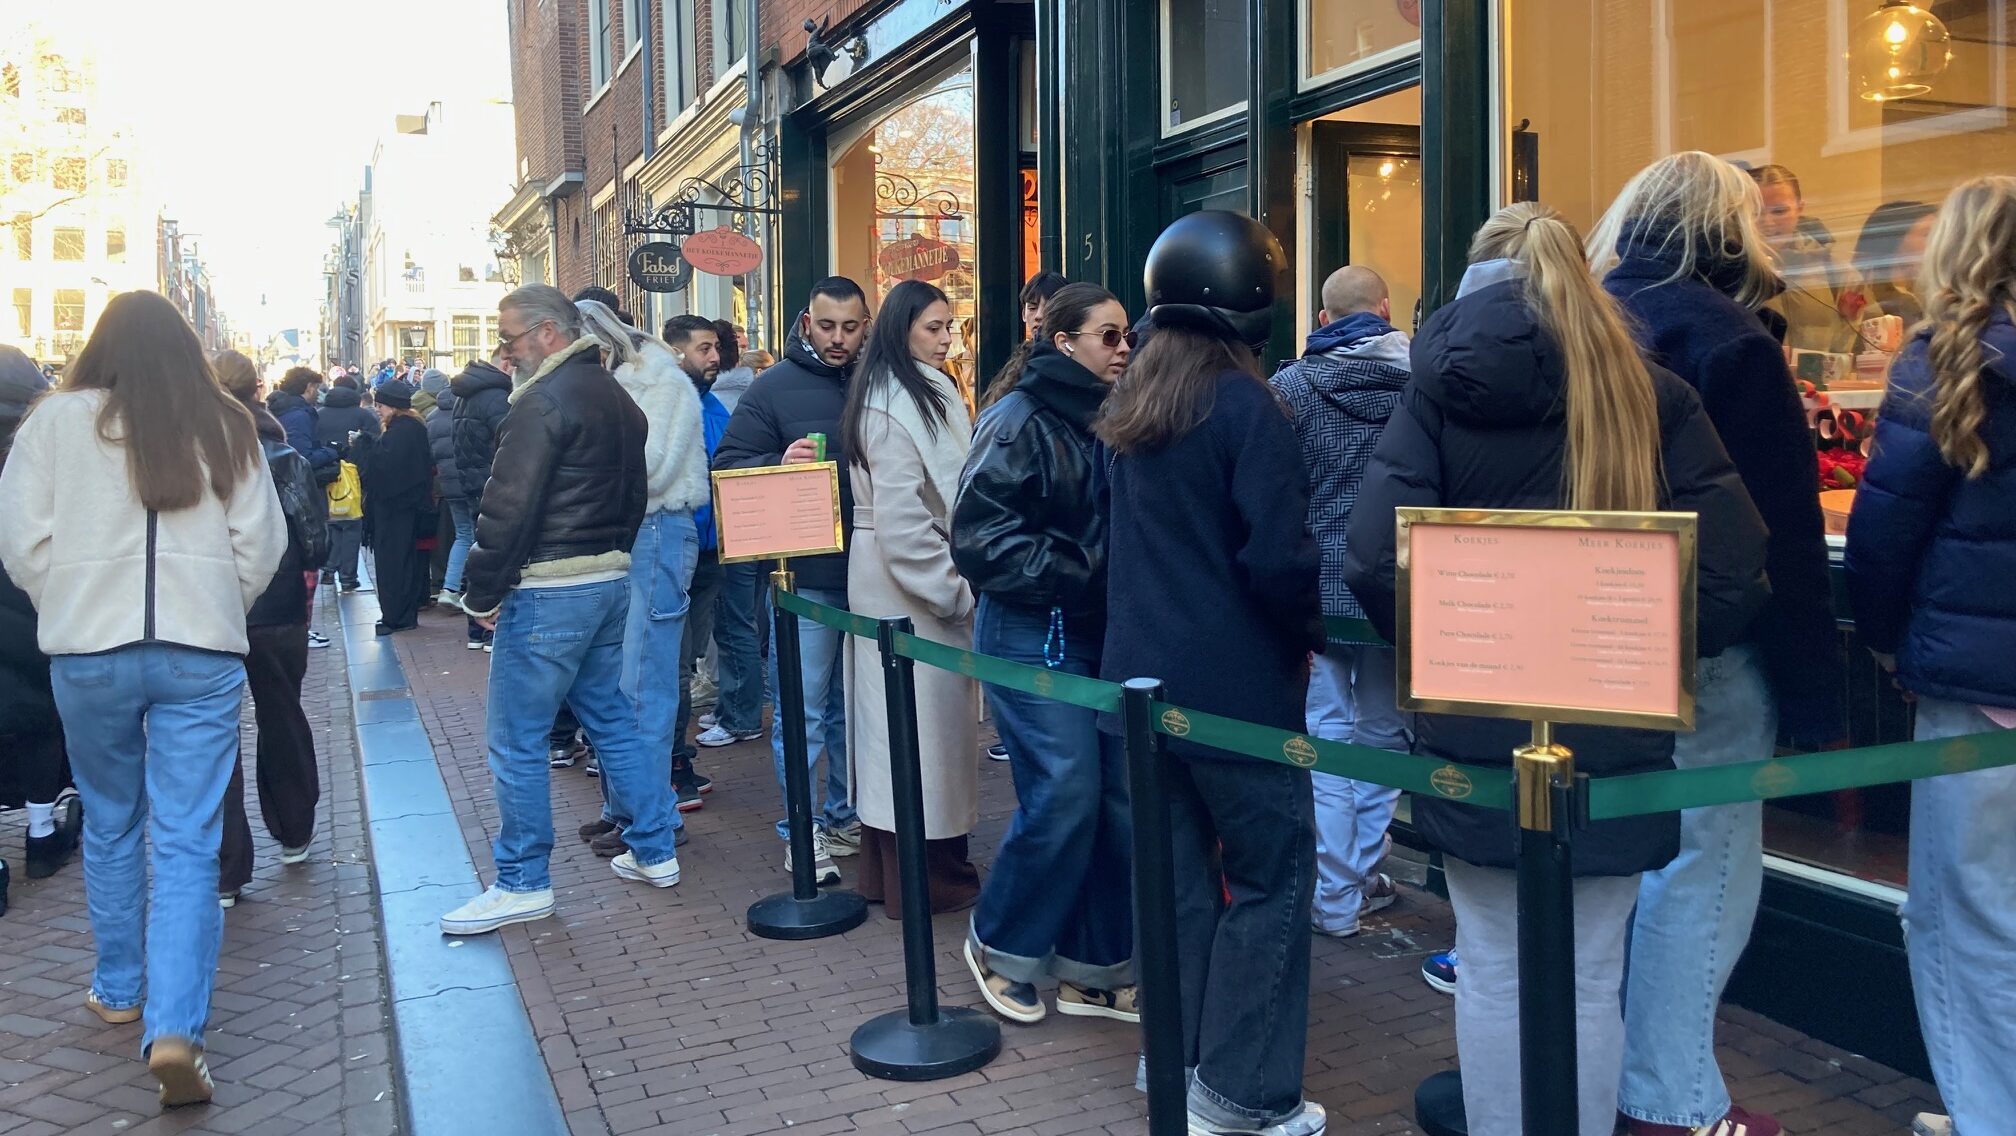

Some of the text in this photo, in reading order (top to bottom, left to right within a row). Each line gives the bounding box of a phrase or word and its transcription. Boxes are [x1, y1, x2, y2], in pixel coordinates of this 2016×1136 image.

[1084, 232, 1093, 261] 5
[636, 251, 682, 276] Fabel
[646, 276, 676, 285] FRIET
